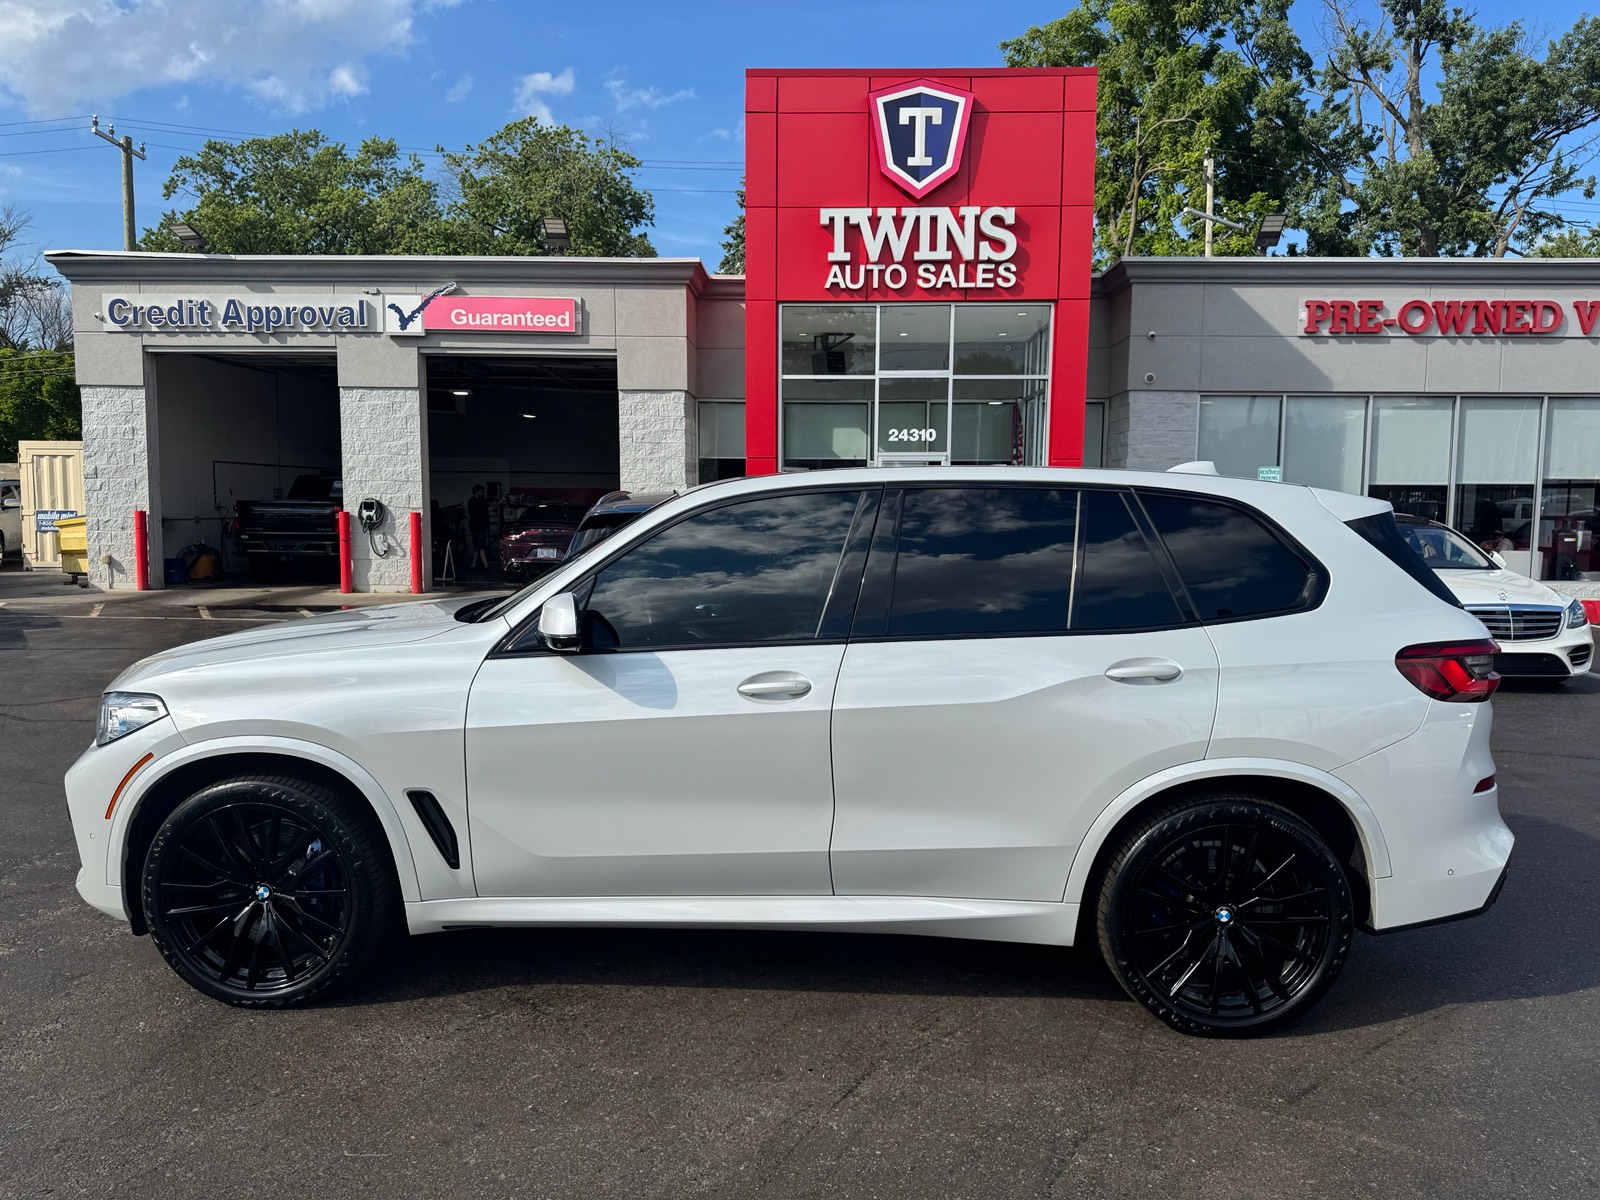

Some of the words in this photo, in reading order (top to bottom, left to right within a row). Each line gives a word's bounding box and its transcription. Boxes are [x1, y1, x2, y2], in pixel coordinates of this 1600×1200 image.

[899, 106, 942, 167] T
[819, 206, 1018, 263] TWINS
[824, 263, 908, 290] AUTO
[916, 262, 1017, 289] SALES
[107, 297, 212, 327] Credit
[221, 298, 368, 333] Approval
[450, 308, 570, 328] Guaranteed
[1304, 299, 1564, 335] PRE-OWNED
[888, 428, 937, 443] 24310
[37, 511, 60, 520] mobile
